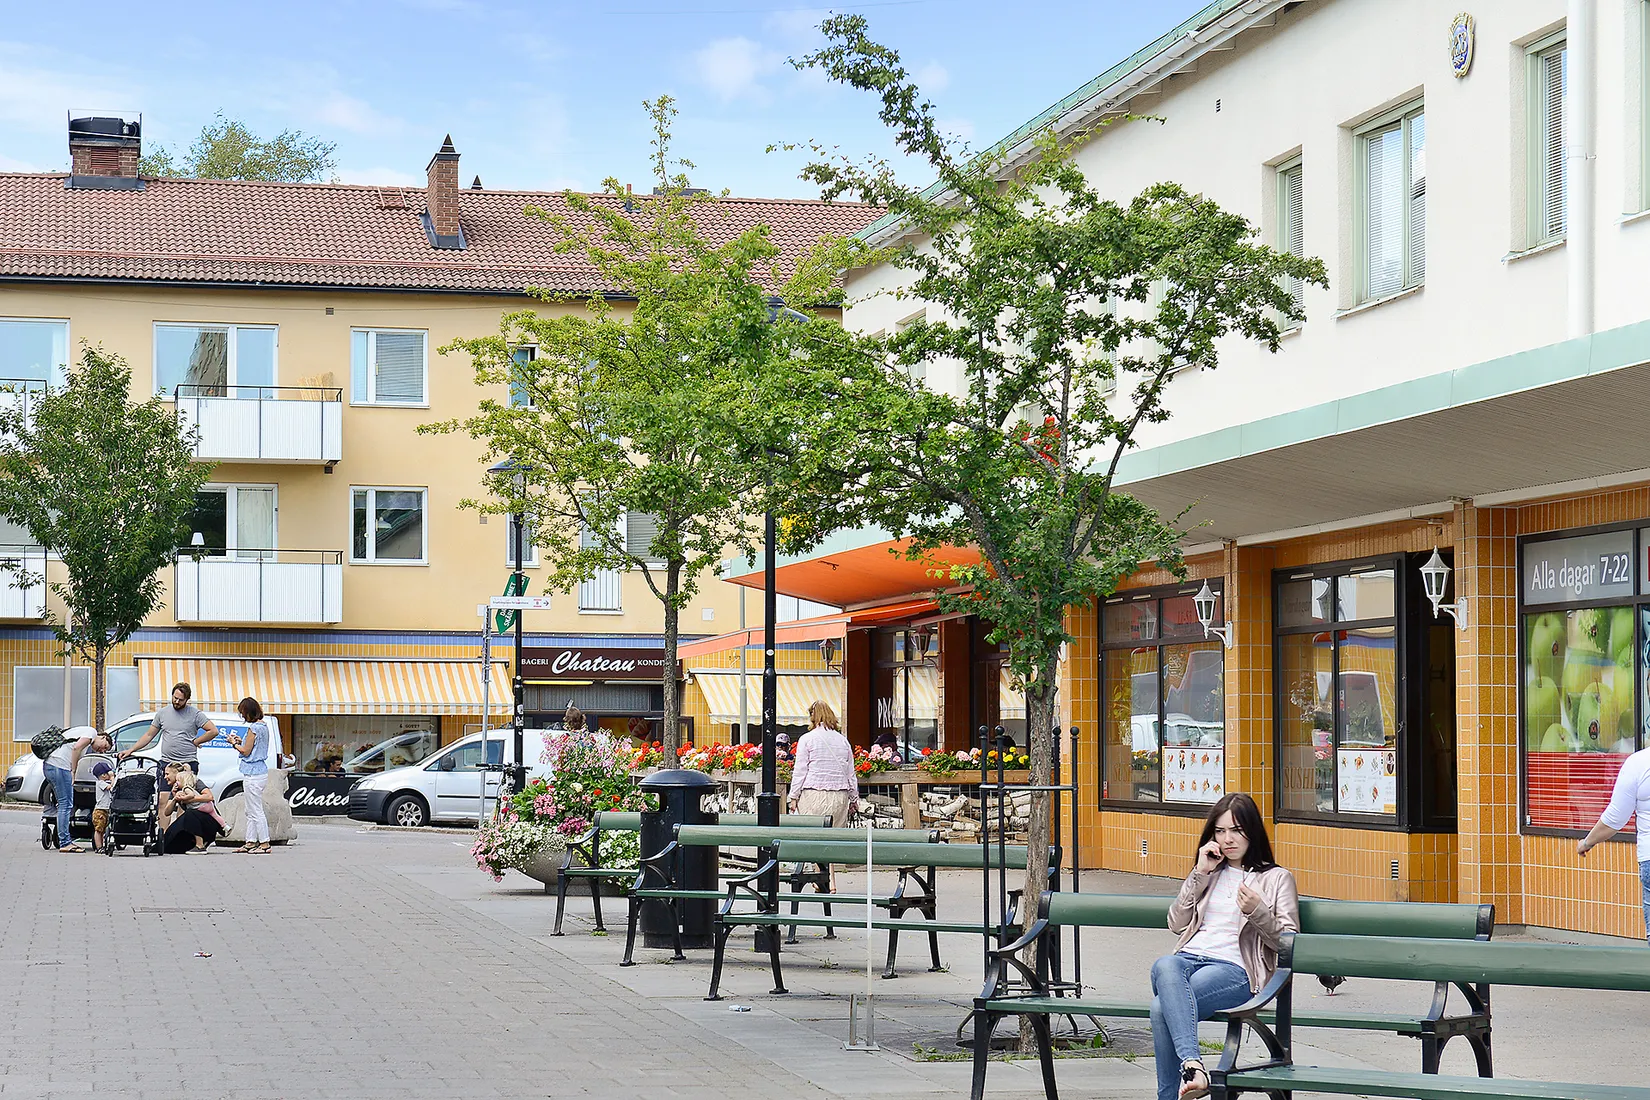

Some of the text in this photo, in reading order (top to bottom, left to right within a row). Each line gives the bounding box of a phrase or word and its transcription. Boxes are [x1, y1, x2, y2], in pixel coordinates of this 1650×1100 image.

[1531, 554, 1629, 595] Alla dagar 7-22
[551, 650, 636, 675] Chateau
[637, 658, 680, 666] KONDII
[288, 786, 350, 808] Chatea
